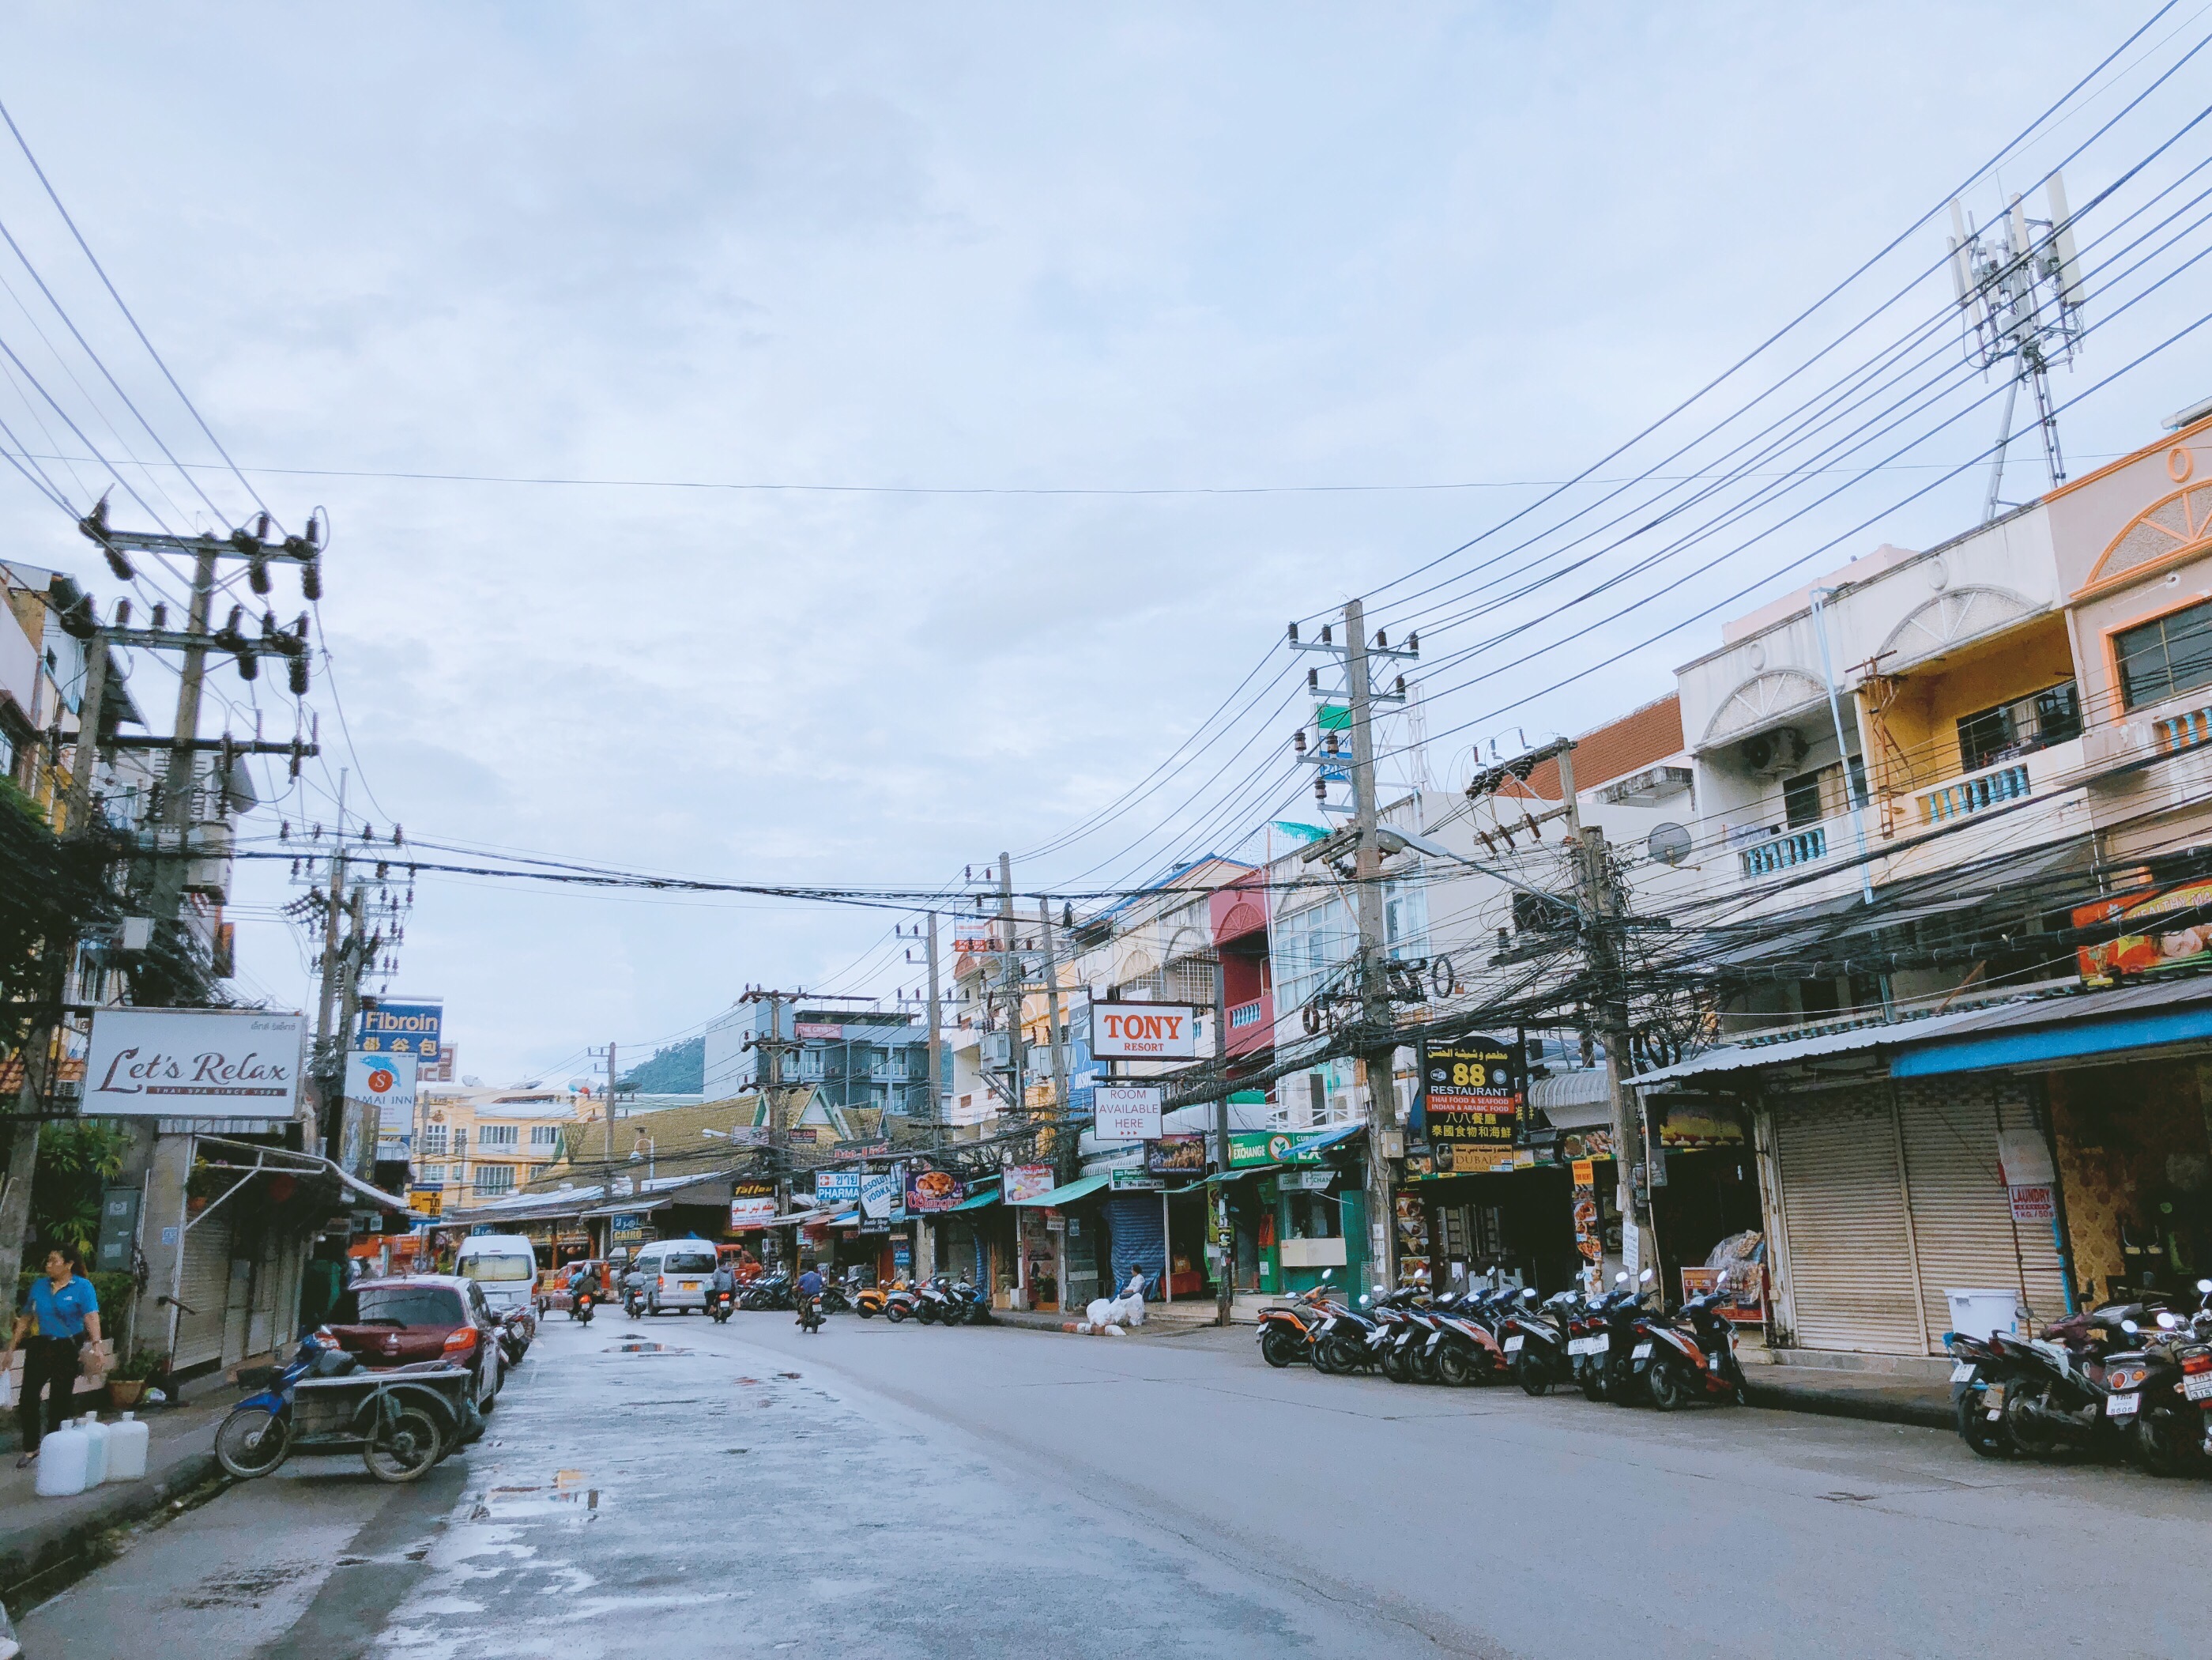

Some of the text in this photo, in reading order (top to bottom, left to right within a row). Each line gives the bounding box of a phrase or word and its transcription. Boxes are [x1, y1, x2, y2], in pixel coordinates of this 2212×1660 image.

[366, 1012, 438, 1031] Fibroin
[1104, 1014, 1182, 1040] TONY
[1125, 1043, 1164, 1051] RESORT
[92, 1047, 290, 1094] Let's Relax
[1453, 1062, 1485, 1087] 88
[1110, 1090, 1146, 1099] ROOM
[1430, 1085, 1508, 1096] RESTAURANT
[1099, 1104, 1158, 1114] AVAILABLE
[1115, 1119, 1144, 1128] HERE
[1432, 1125, 1512, 1139] 泰國食物和海鮮
[1234, 1145, 1265, 1159] EXCHANGE
[1456, 1156, 1492, 1164] DUBAI
[861, 1174, 888, 1194] ABSOLUT
[866, 1185, 891, 1202] VODKA
[2012, 1188, 2050, 1203] LAUNDRY
[613, 1230, 642, 1239] CAIRO
